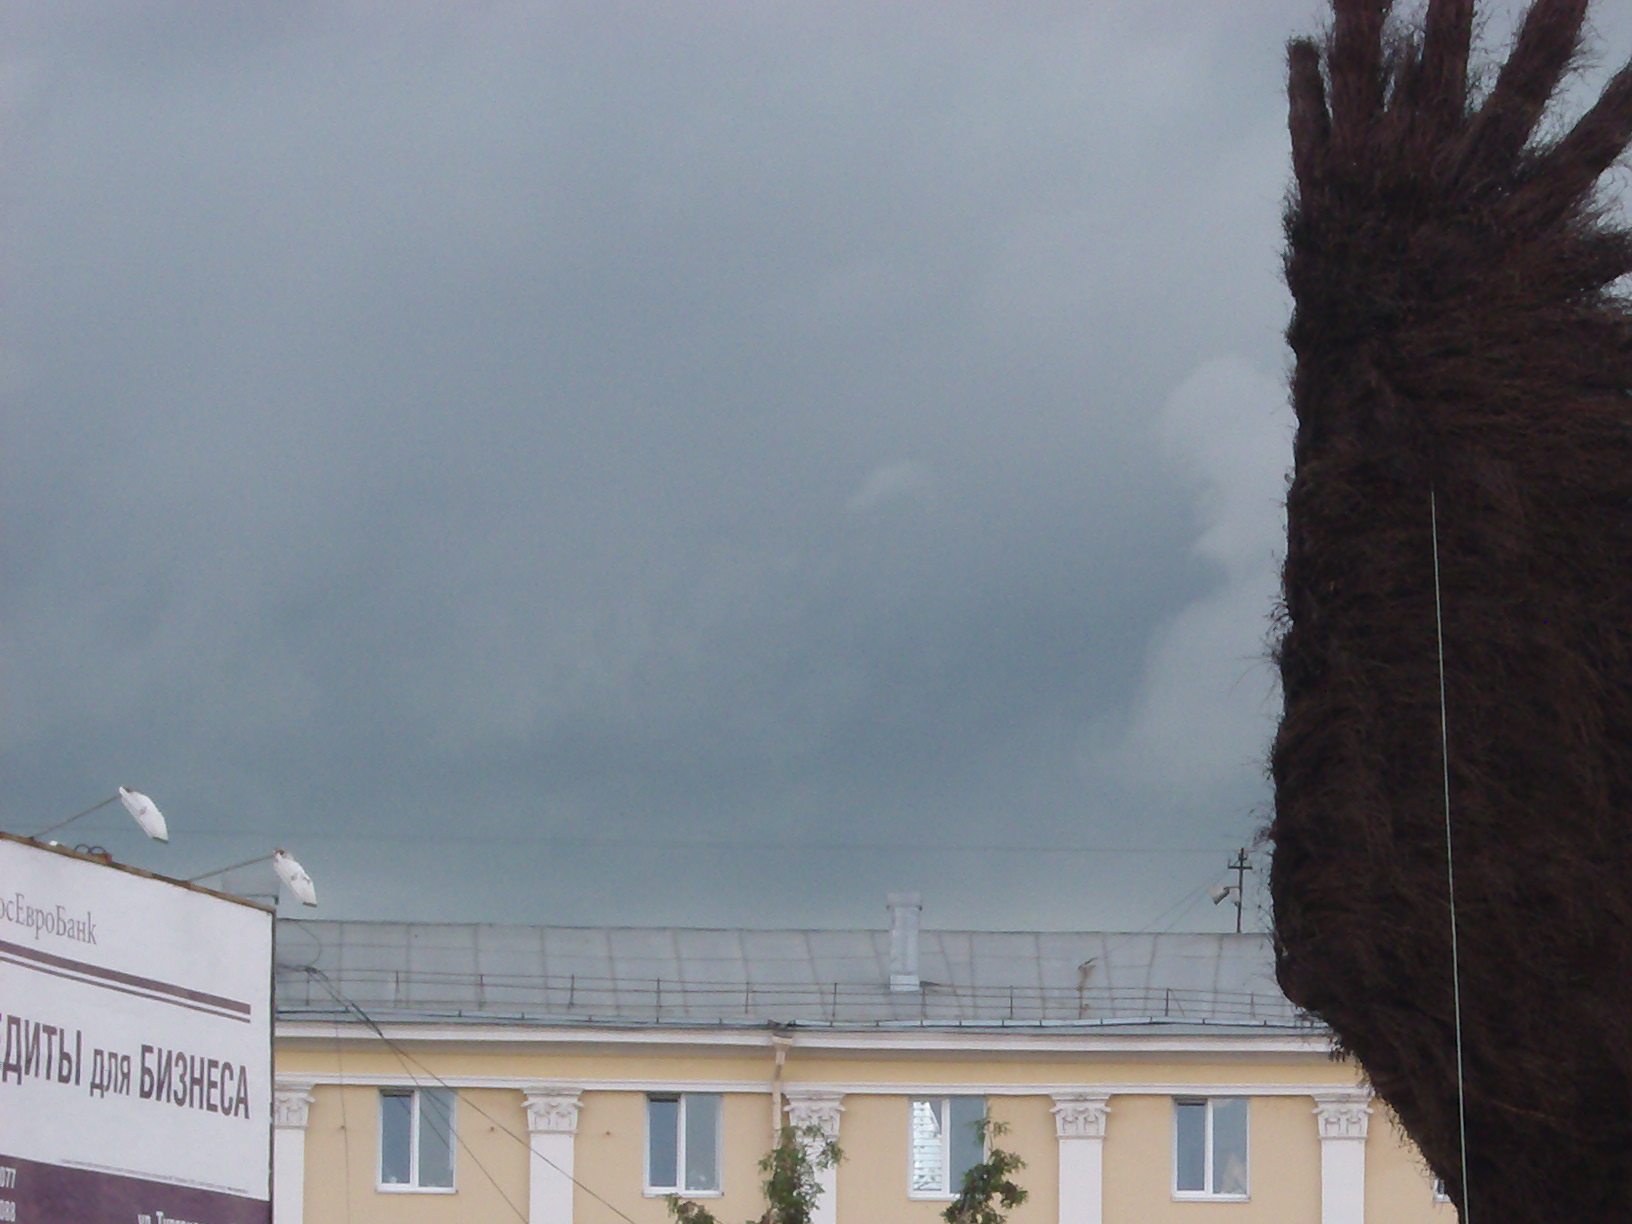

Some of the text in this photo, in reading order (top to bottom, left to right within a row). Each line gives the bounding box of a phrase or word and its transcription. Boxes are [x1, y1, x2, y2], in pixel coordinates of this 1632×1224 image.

[0, 1011, 250, 1120] ДИТЫ для БИЗНЕСА
